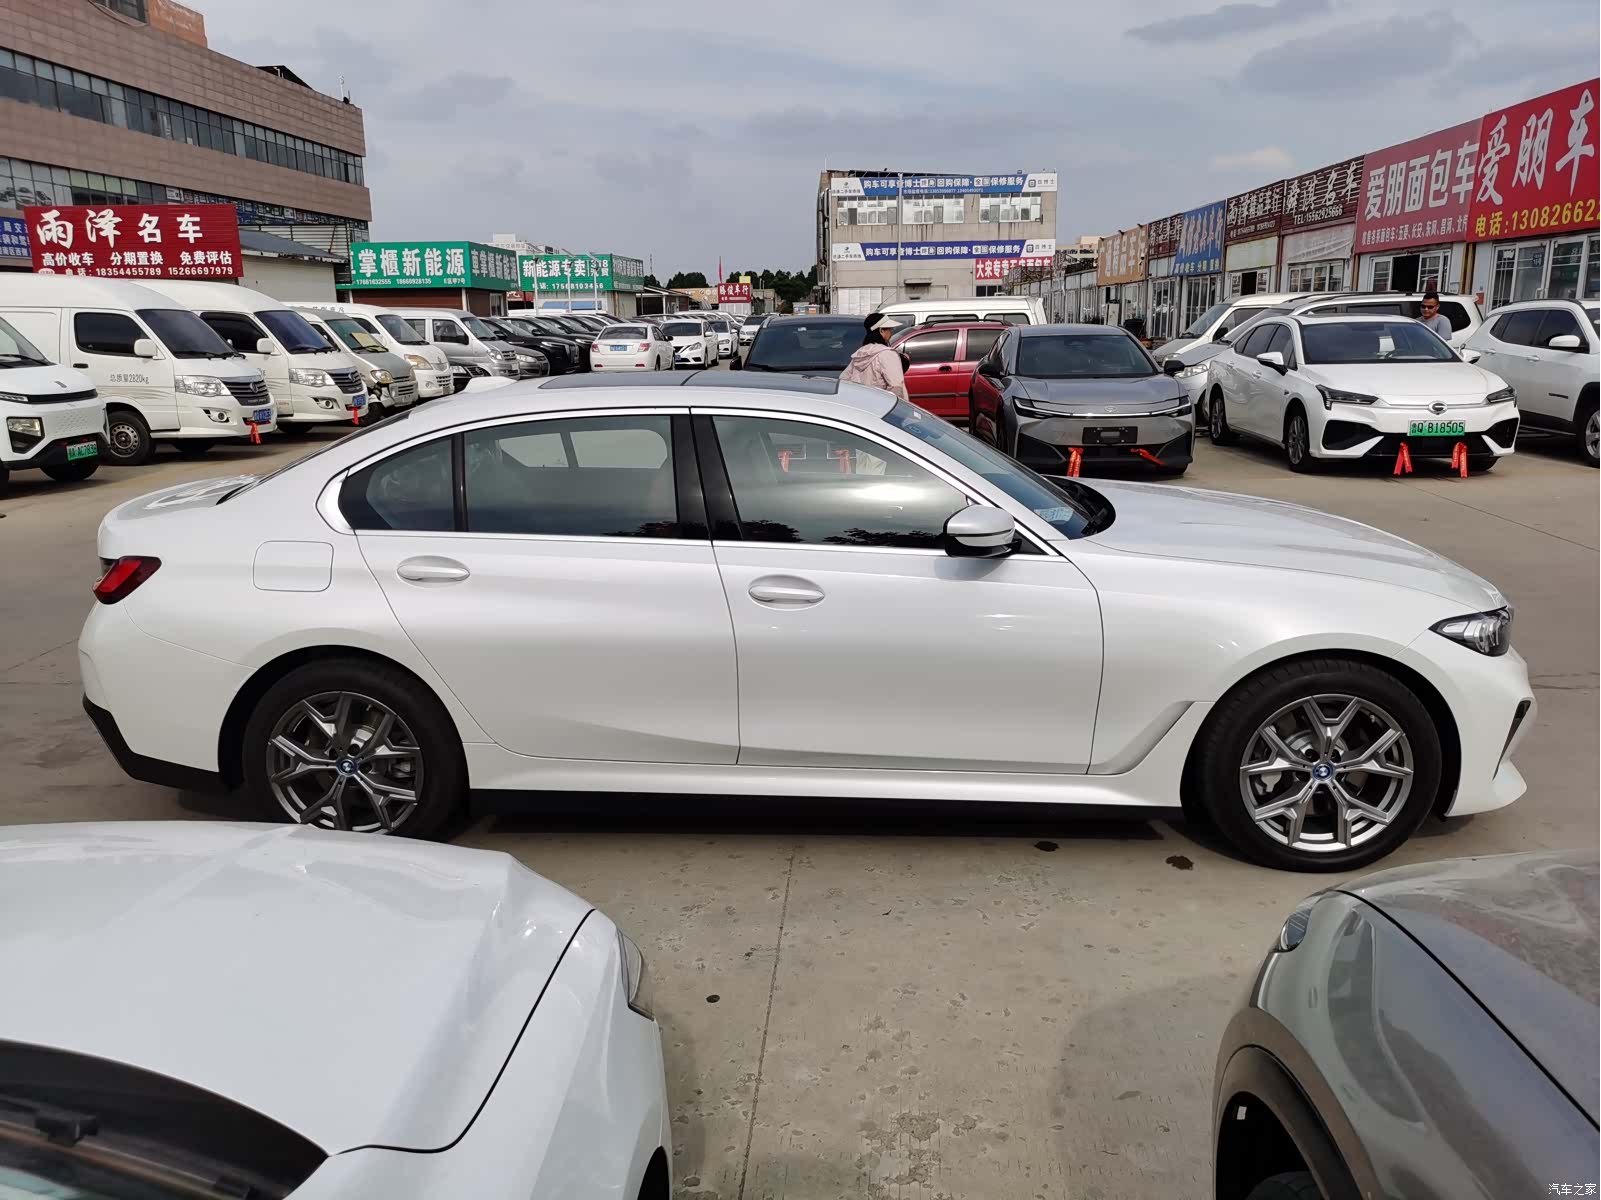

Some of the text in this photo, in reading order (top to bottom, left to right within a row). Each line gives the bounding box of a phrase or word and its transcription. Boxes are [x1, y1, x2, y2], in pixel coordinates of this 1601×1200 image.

[1366, 140, 1480, 221] 爱朋面包车
[37, 208, 203, 249] 雨泽名车
[1475, 198, 1601, 237] 电话:13082662
[41, 250, 233, 267] 高价收车 分期置换 免费评估
[168, 266, 233, 275] 15266697979
